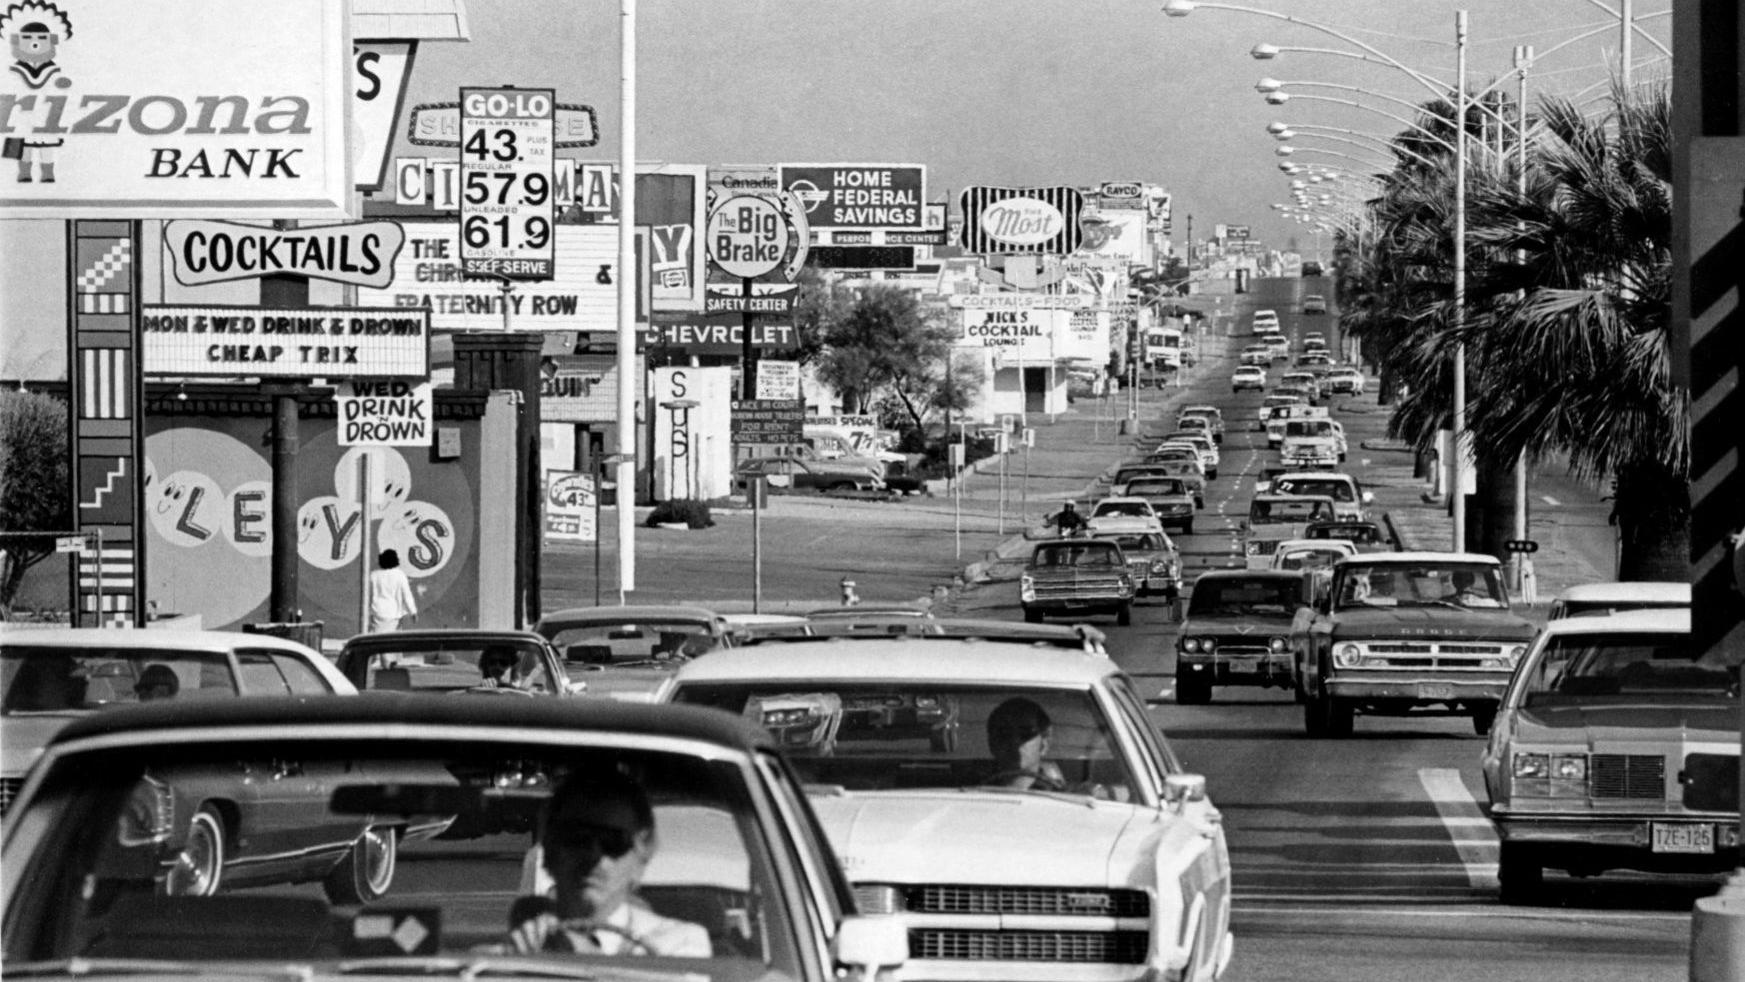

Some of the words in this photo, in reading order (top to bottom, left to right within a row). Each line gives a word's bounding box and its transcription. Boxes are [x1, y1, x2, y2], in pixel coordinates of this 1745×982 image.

[144, 148, 303, 178] BANK
[463, 162, 512, 170] REGULAR
[400, 164, 612, 207] CIMA
[465, 171, 549, 205] 57.9
[834, 170, 892, 187] HOME
[834, 189, 918, 206] FEDERAL
[1106, 186, 1138, 195] RAYCO
[464, 206, 518, 214] UNLEADED
[834, 207, 916, 224] SAVINGS
[718, 212, 736, 228] The
[738, 207, 777, 241] Big
[988, 206, 1053, 237] Most
[464, 215, 550, 249] 61.9
[837, 233, 902, 243] PERFORNCE
[904, 233, 940, 243] CENTER
[184, 230, 381, 275] COCKTAILS
[411, 239, 450, 259] THE
[716, 235, 779, 262] Brake
[503, 261, 547, 274] SERVE
[596, 264, 613, 285] &
[532, 295, 578, 315] ROW
[707, 298, 746, 311] SAFETY
[749, 298, 788, 311] CENTER
[143, 315, 188, 333] MON
[211, 317, 256, 334] WED
[262, 317, 326, 335] DRINK
[350, 318, 422, 336] DROWN
[645, 325, 793, 344] CHEVROLET
[968, 325, 1042, 336] COCKTAIL
[206, 344, 284, 362] CHEAP
[298, 346, 359, 363] TRIX
[352, 381, 415, 398] WED.
[345, 398, 427, 421] DRINK
[346, 421, 425, 443] DROWN
